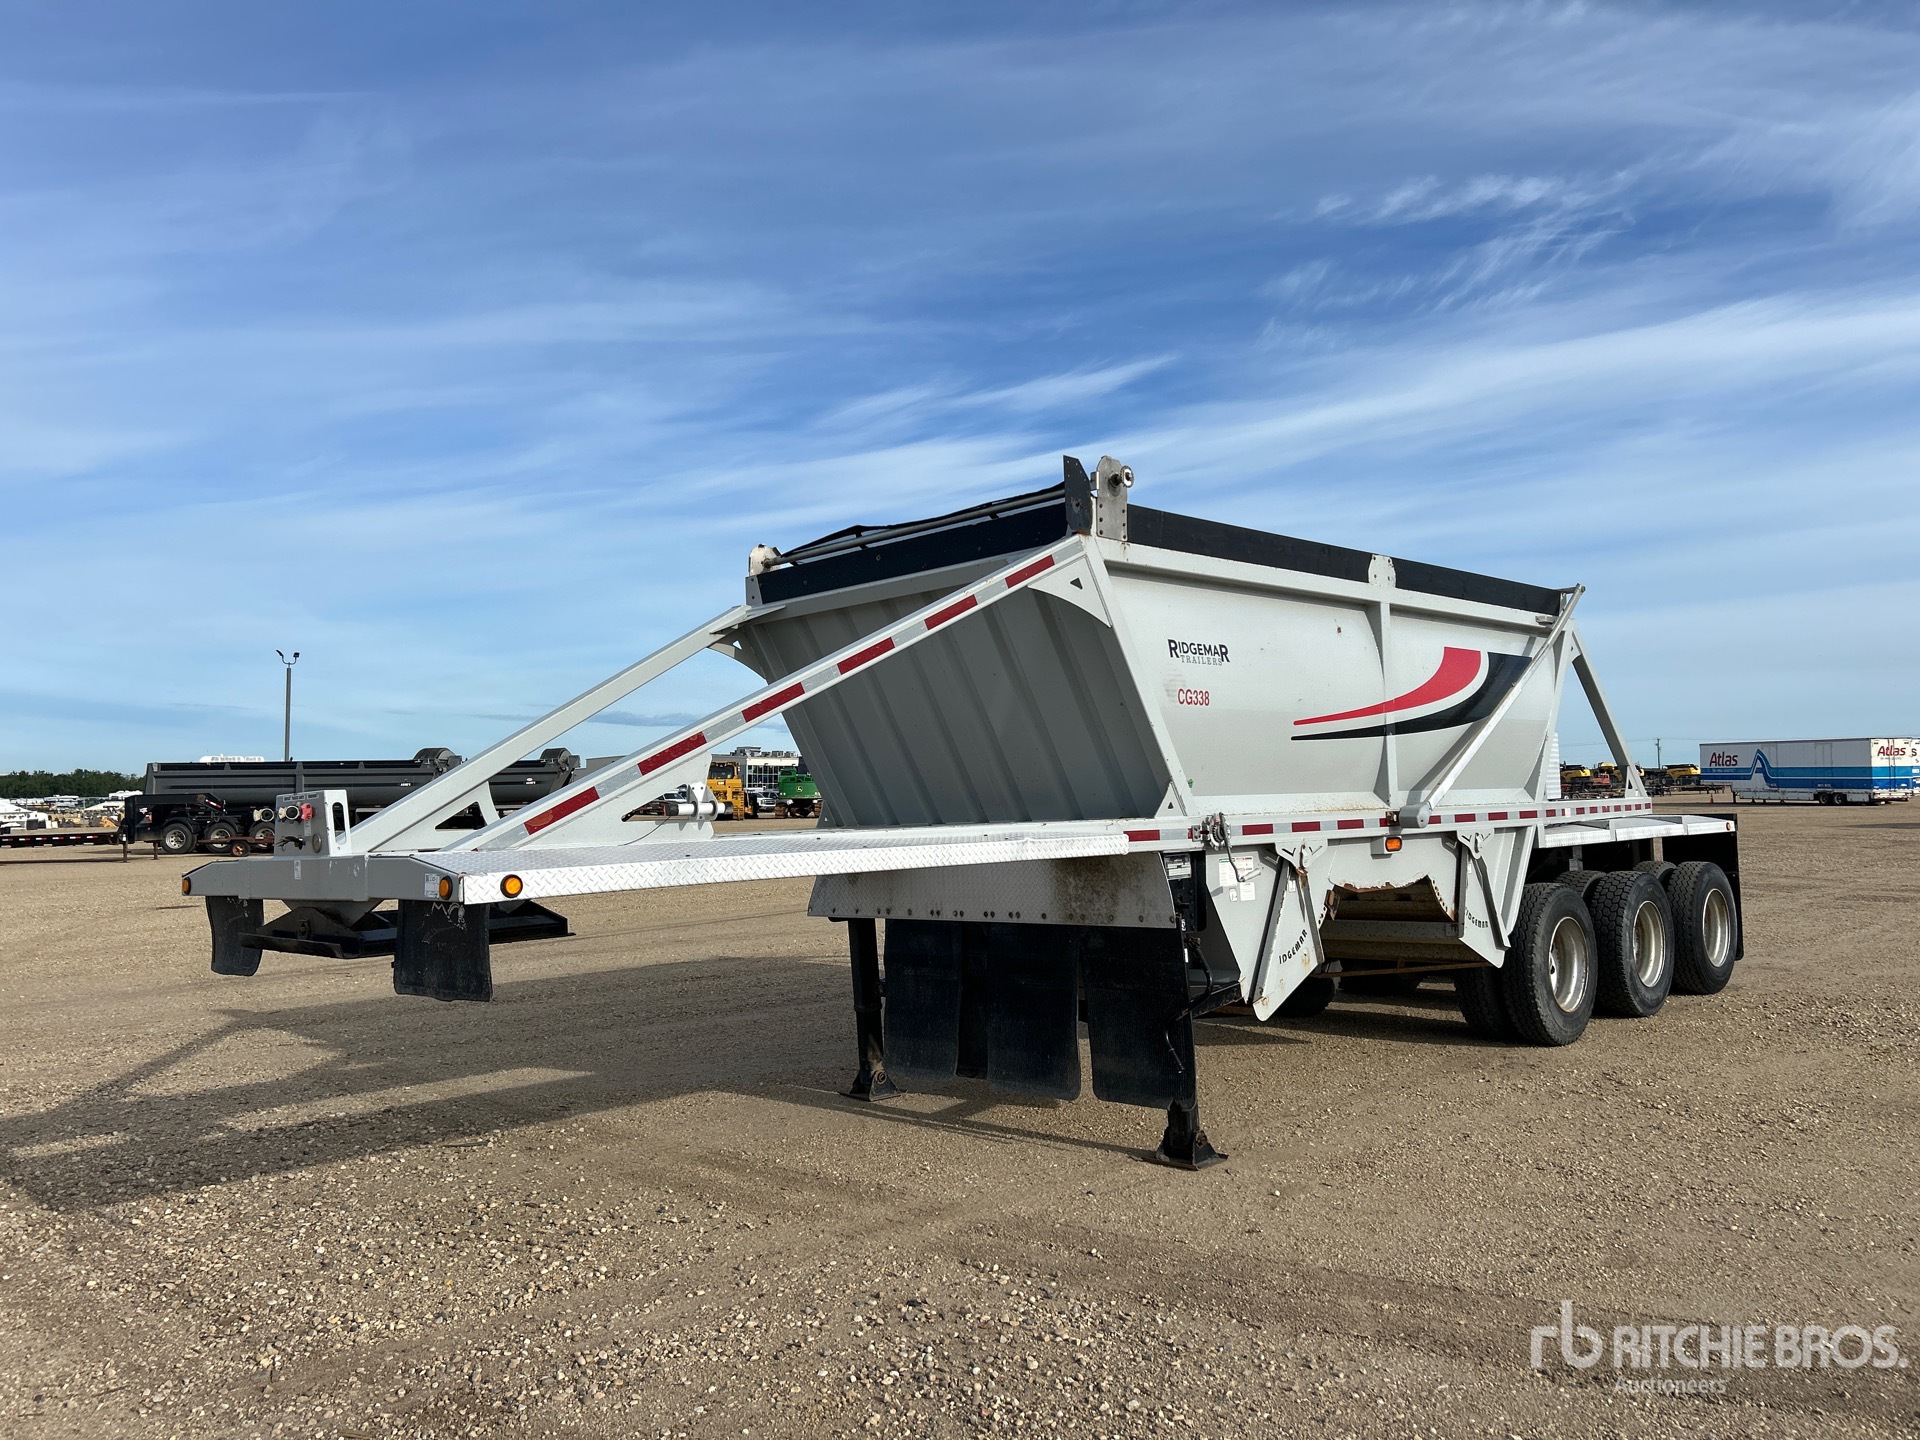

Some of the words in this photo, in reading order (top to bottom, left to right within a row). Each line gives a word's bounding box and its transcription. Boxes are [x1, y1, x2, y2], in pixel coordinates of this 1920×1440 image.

[1168, 639, 1230, 662] RIDGEMAR
[1180, 655, 1222, 666] TRAILERS
[1178, 688, 1210, 706] CG338
[1877, 745, 1906, 756] Atlas
[1709, 752, 1738, 767] Atlas
